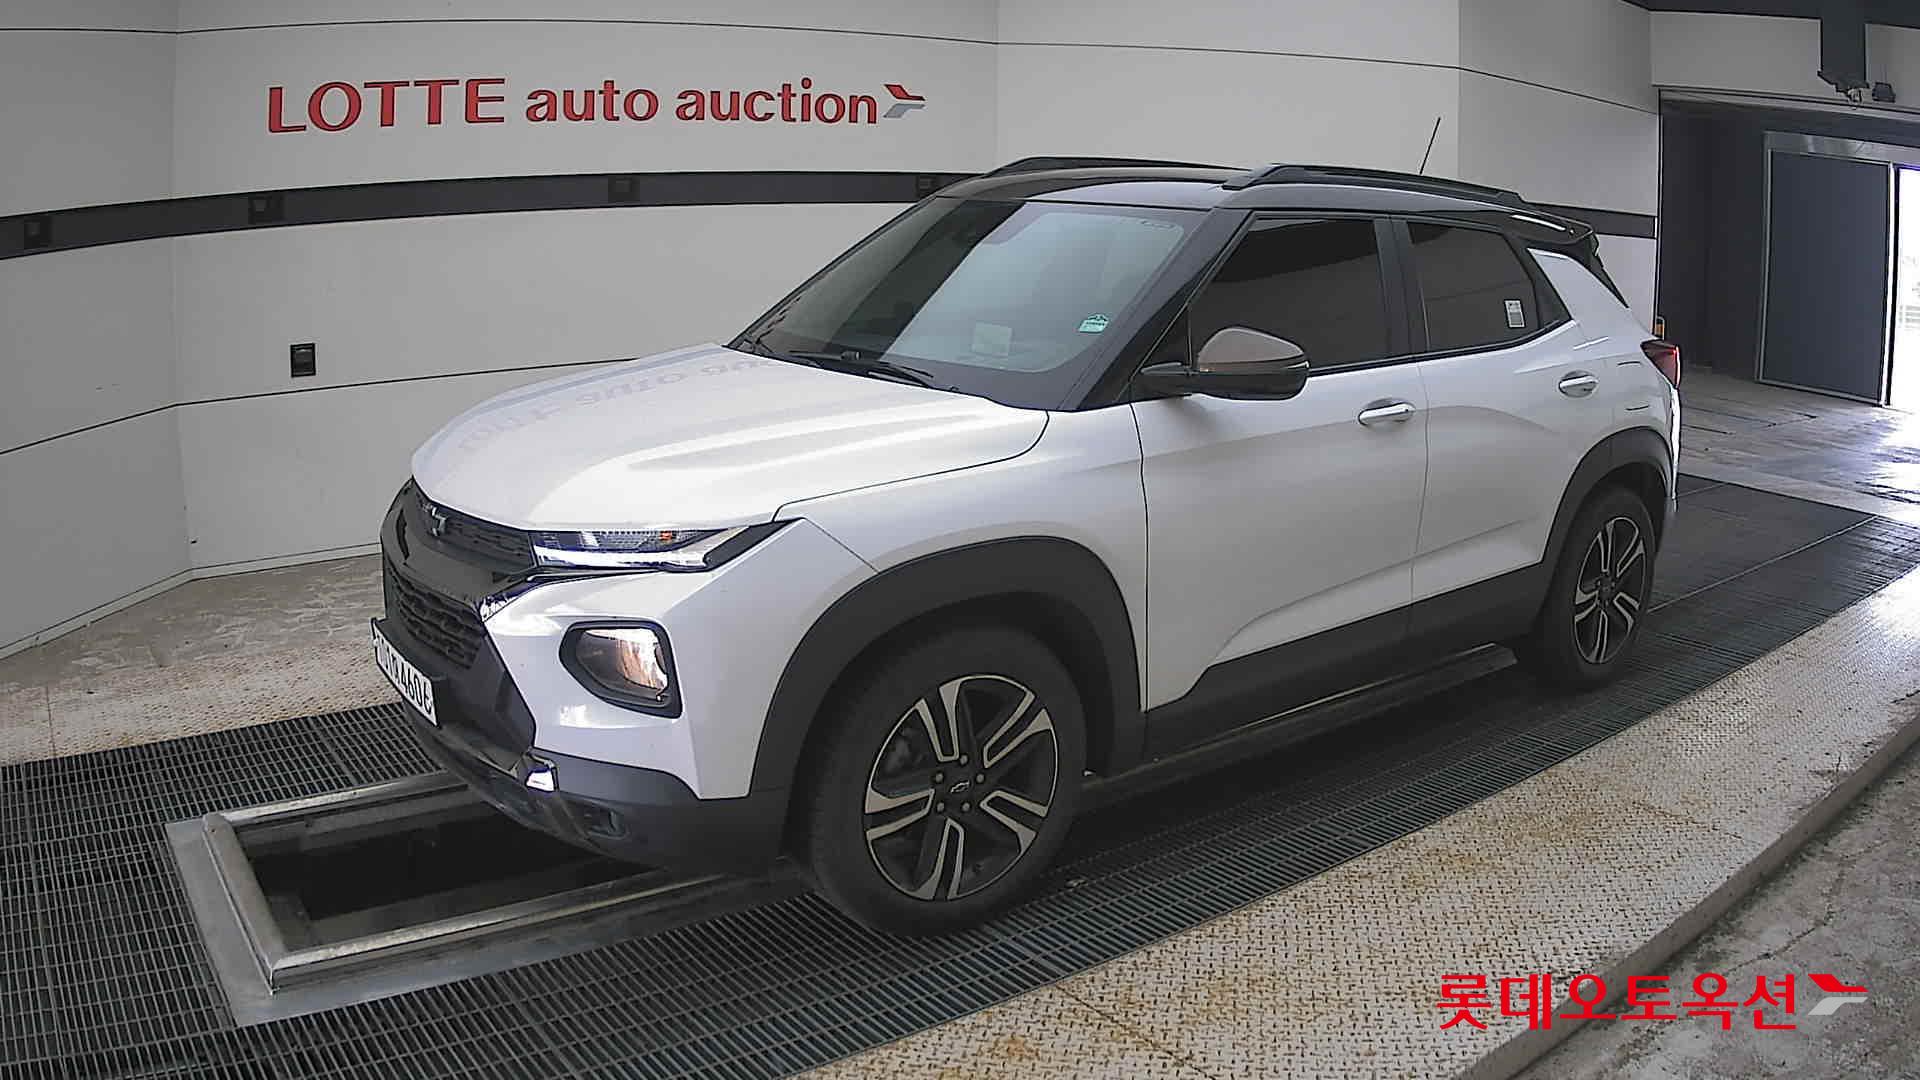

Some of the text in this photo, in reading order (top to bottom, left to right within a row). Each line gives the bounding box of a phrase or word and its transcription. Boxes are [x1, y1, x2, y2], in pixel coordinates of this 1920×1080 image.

[268, 78, 879, 133] LOTTE auto auction
